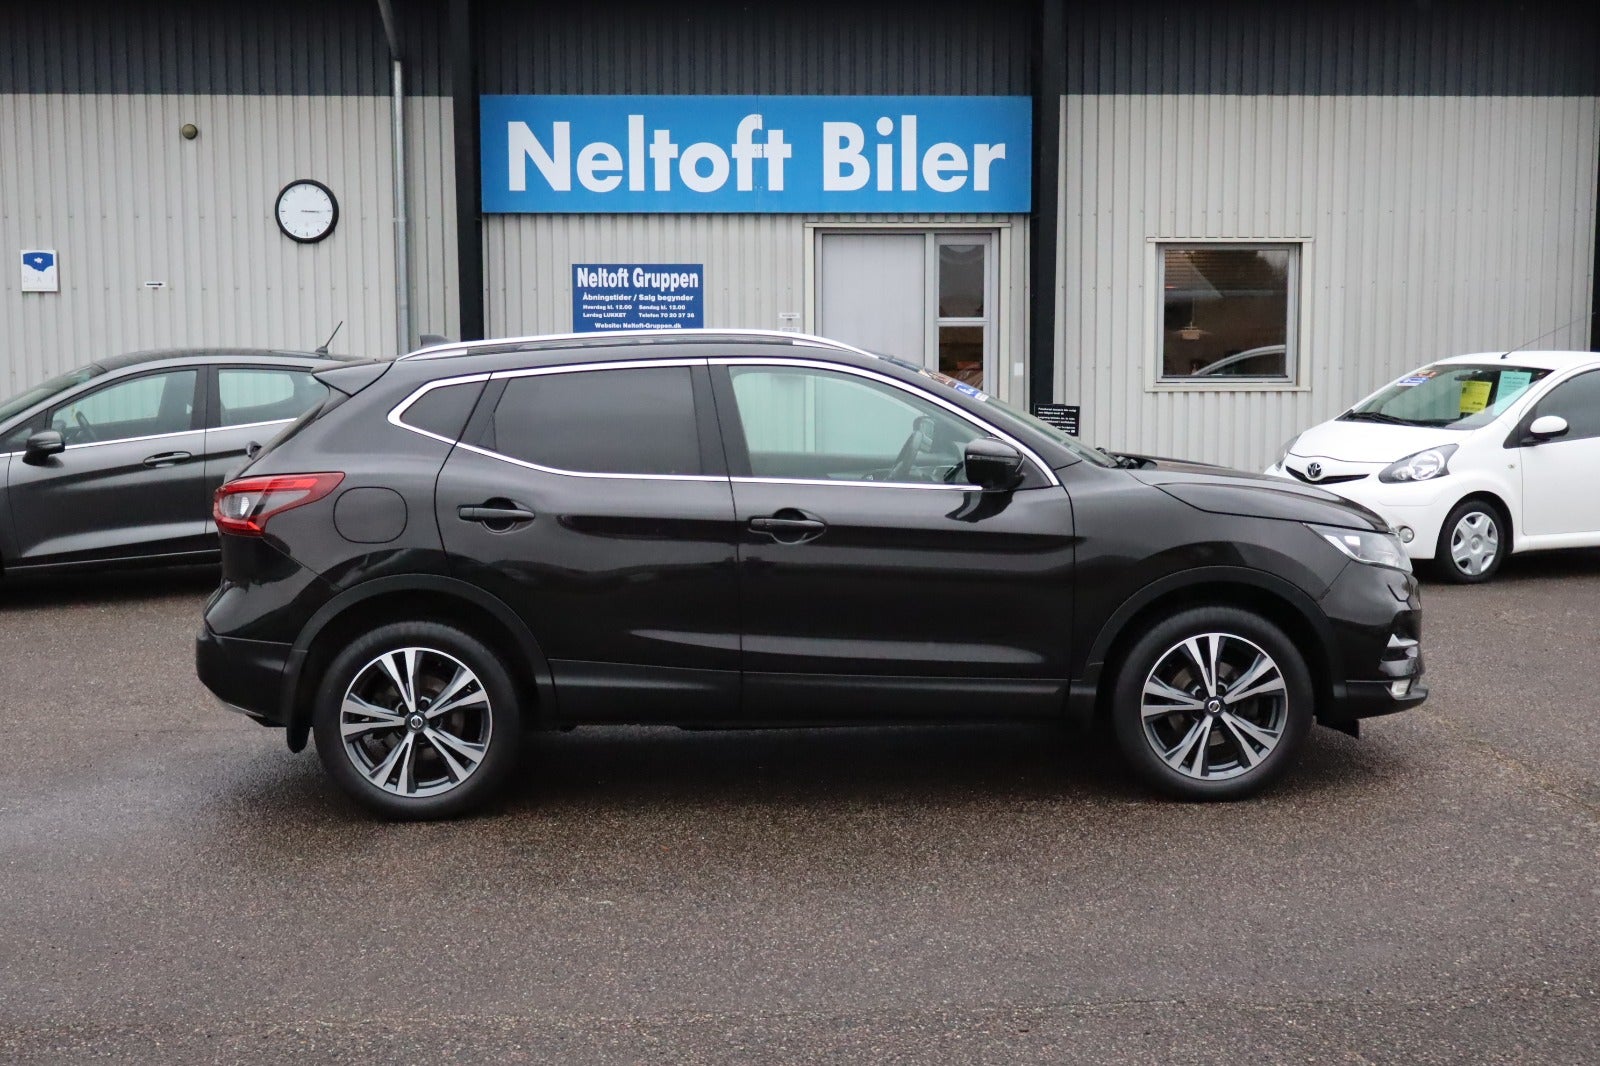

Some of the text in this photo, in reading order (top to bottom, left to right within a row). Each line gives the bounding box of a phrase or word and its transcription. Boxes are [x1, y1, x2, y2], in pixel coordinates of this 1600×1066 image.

[508, 113, 1006, 192] Neltoft Biler
[577, 267, 698, 292] Neltoft Gruppen
[582, 292, 632, 302] Åbningstider
[638, 294, 656, 302] Salg
[657, 294, 694, 302] begynder
